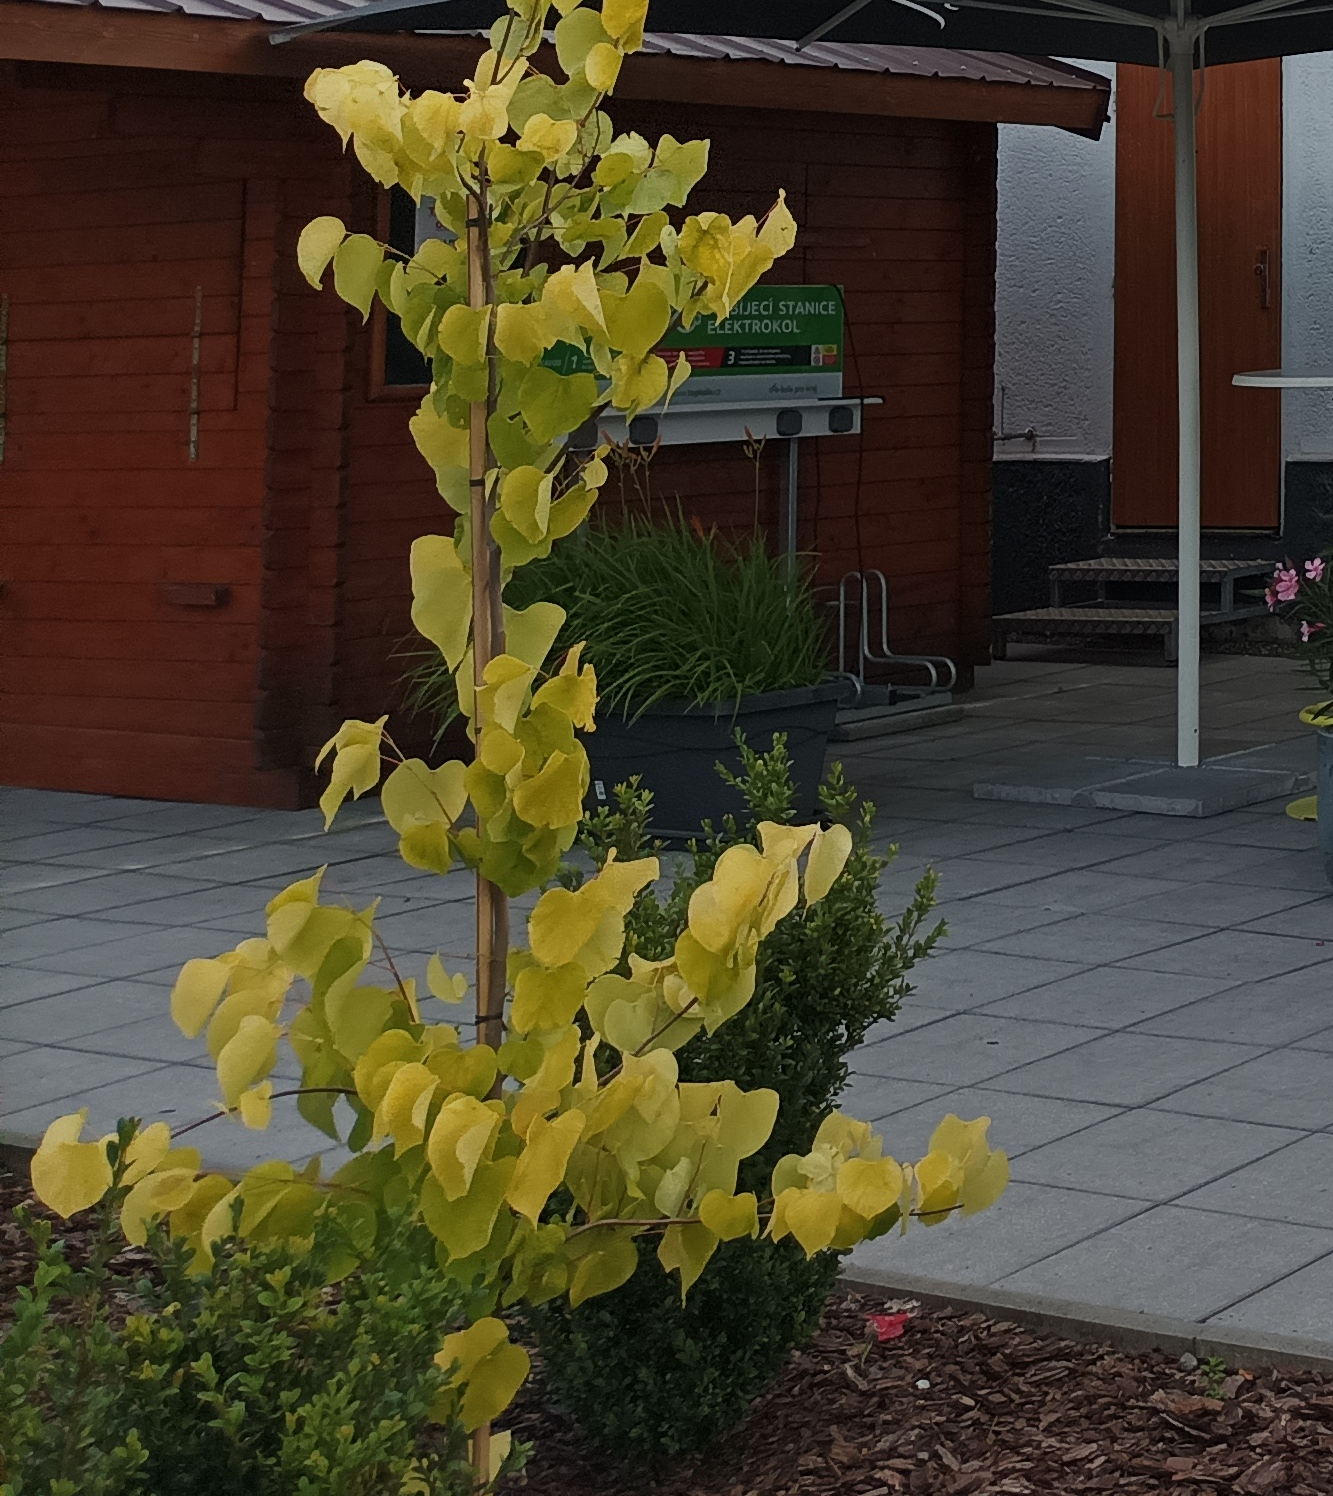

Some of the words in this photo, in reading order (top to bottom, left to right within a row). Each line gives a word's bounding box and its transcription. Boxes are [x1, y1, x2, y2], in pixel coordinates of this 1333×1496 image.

[779, 301, 836, 316] STANICE
[707, 319, 802, 335] ELEKTROKOL
[727, 350, 736, 365] 3
